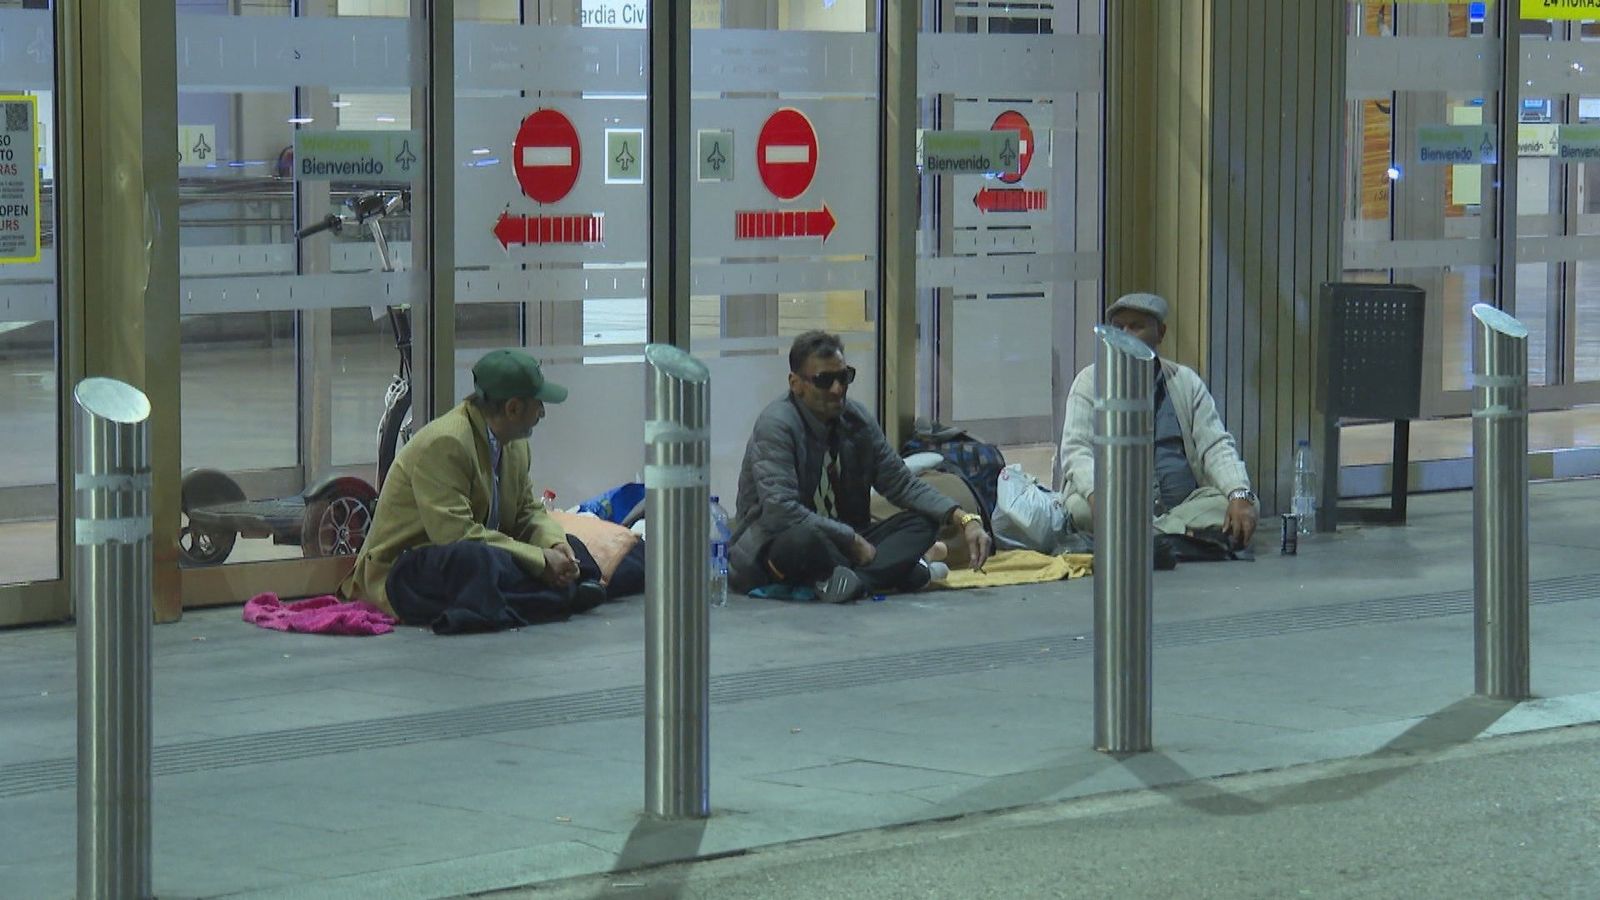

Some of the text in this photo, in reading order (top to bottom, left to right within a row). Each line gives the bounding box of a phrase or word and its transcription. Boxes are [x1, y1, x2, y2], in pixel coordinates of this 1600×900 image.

[1421, 147, 1473, 161] Bienvenido
[302, 157, 384, 175] Bienvenido
[928, 155, 990, 170] Bienvenido
